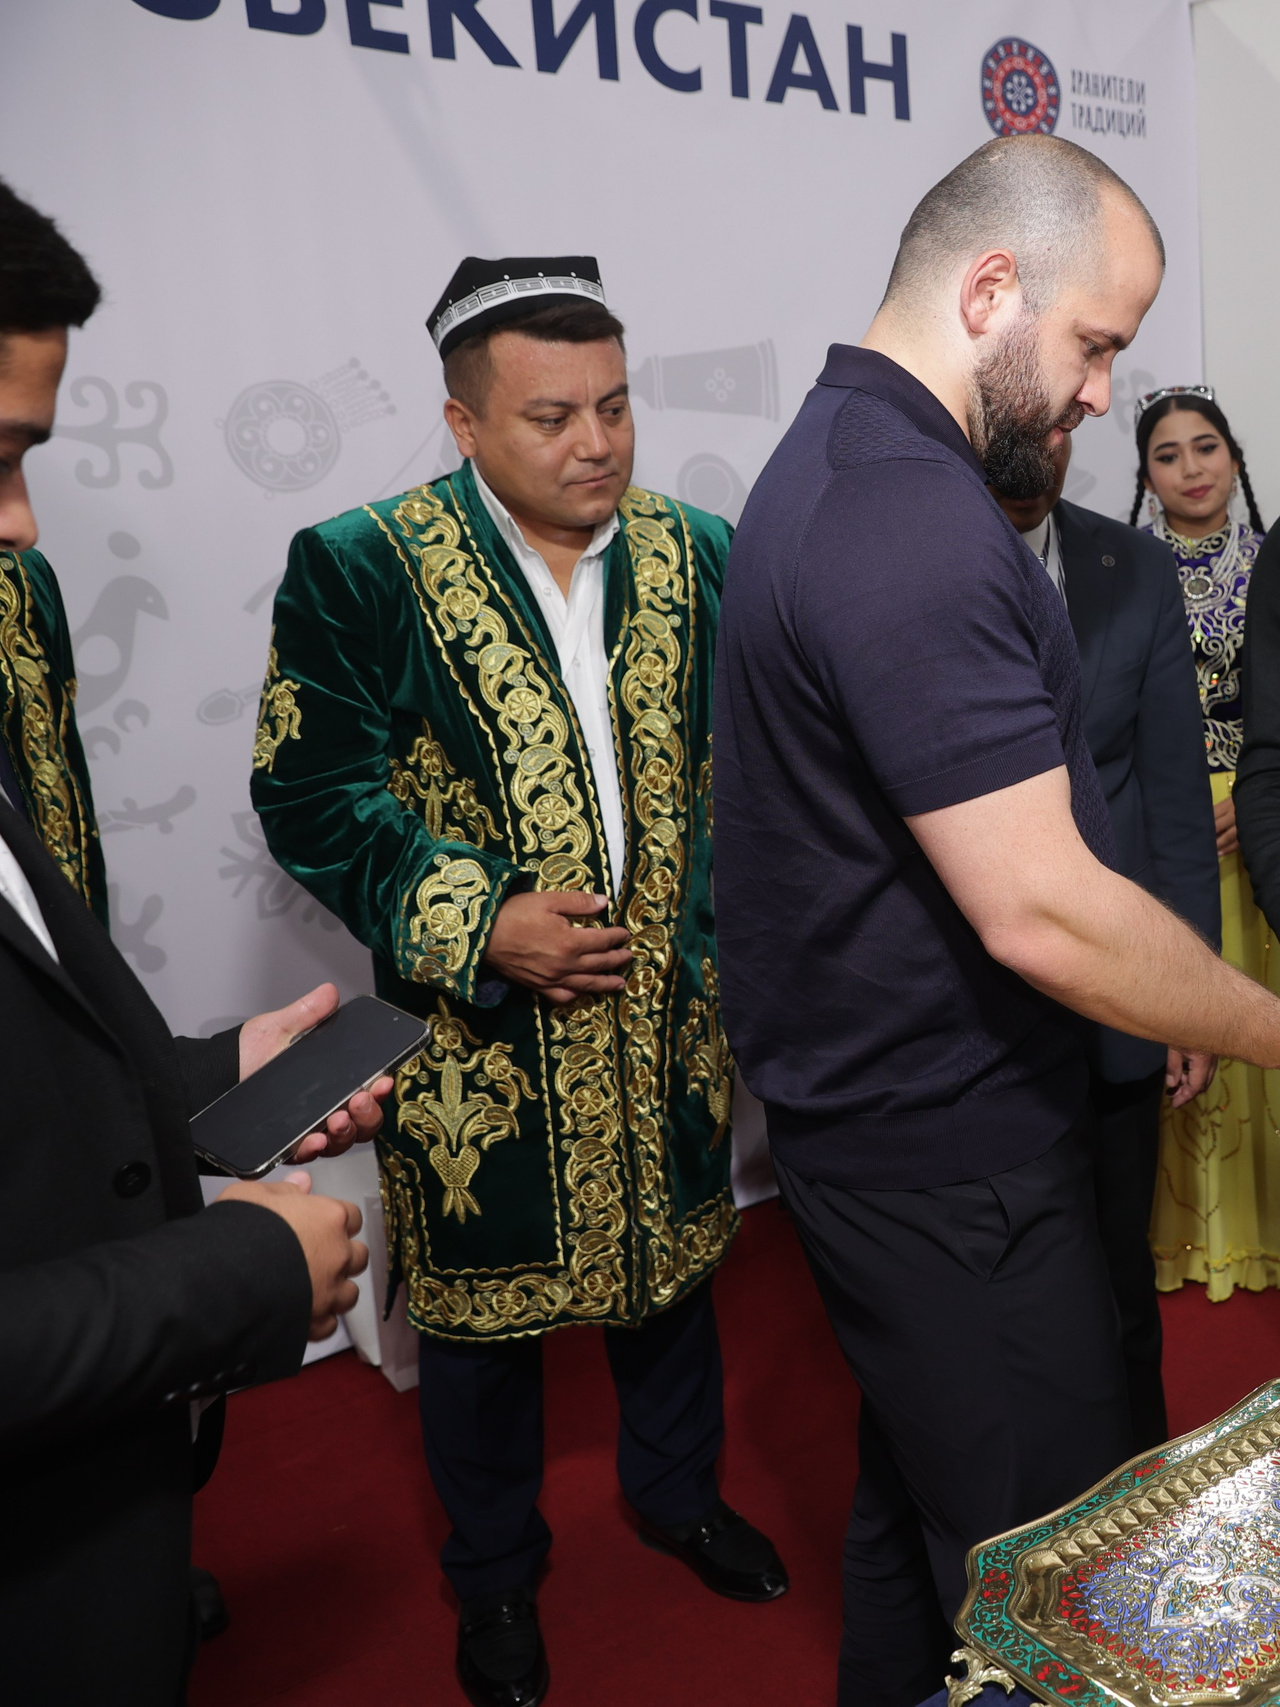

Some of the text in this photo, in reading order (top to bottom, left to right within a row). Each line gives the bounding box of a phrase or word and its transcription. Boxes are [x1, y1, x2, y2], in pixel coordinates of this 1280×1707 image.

[131, 0, 911, 122] КИСТАН
[1070, 69, 1146, 106] ХРАНИТЕЛИ
[1070, 101, 1147, 139] ТРАДИЦИЙ
